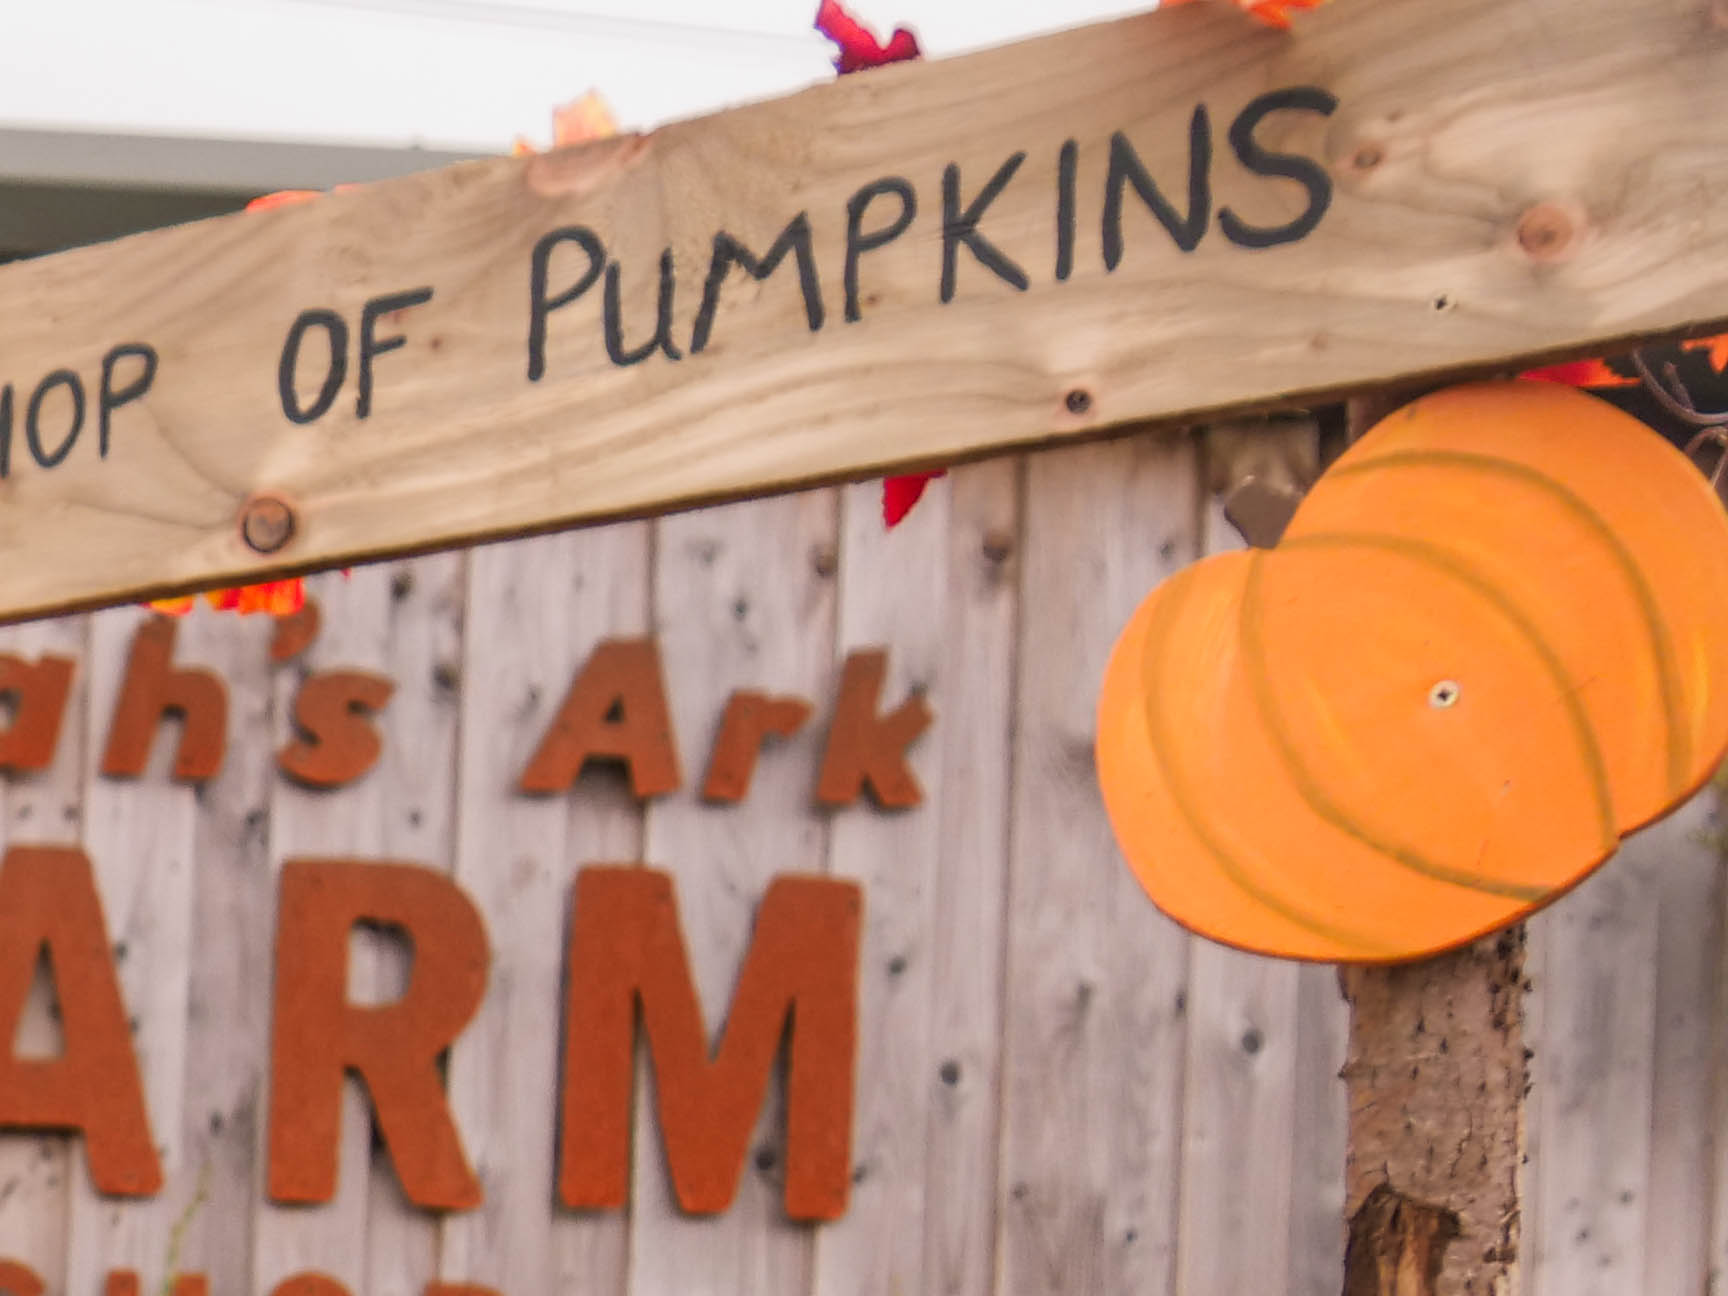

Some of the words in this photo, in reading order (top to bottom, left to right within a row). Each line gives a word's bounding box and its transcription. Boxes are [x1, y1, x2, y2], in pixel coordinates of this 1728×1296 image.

[277, 286, 435, 425] OF
[527, 85, 1341, 382] PUMPKINS
[519, 635, 936, 809] Ark
